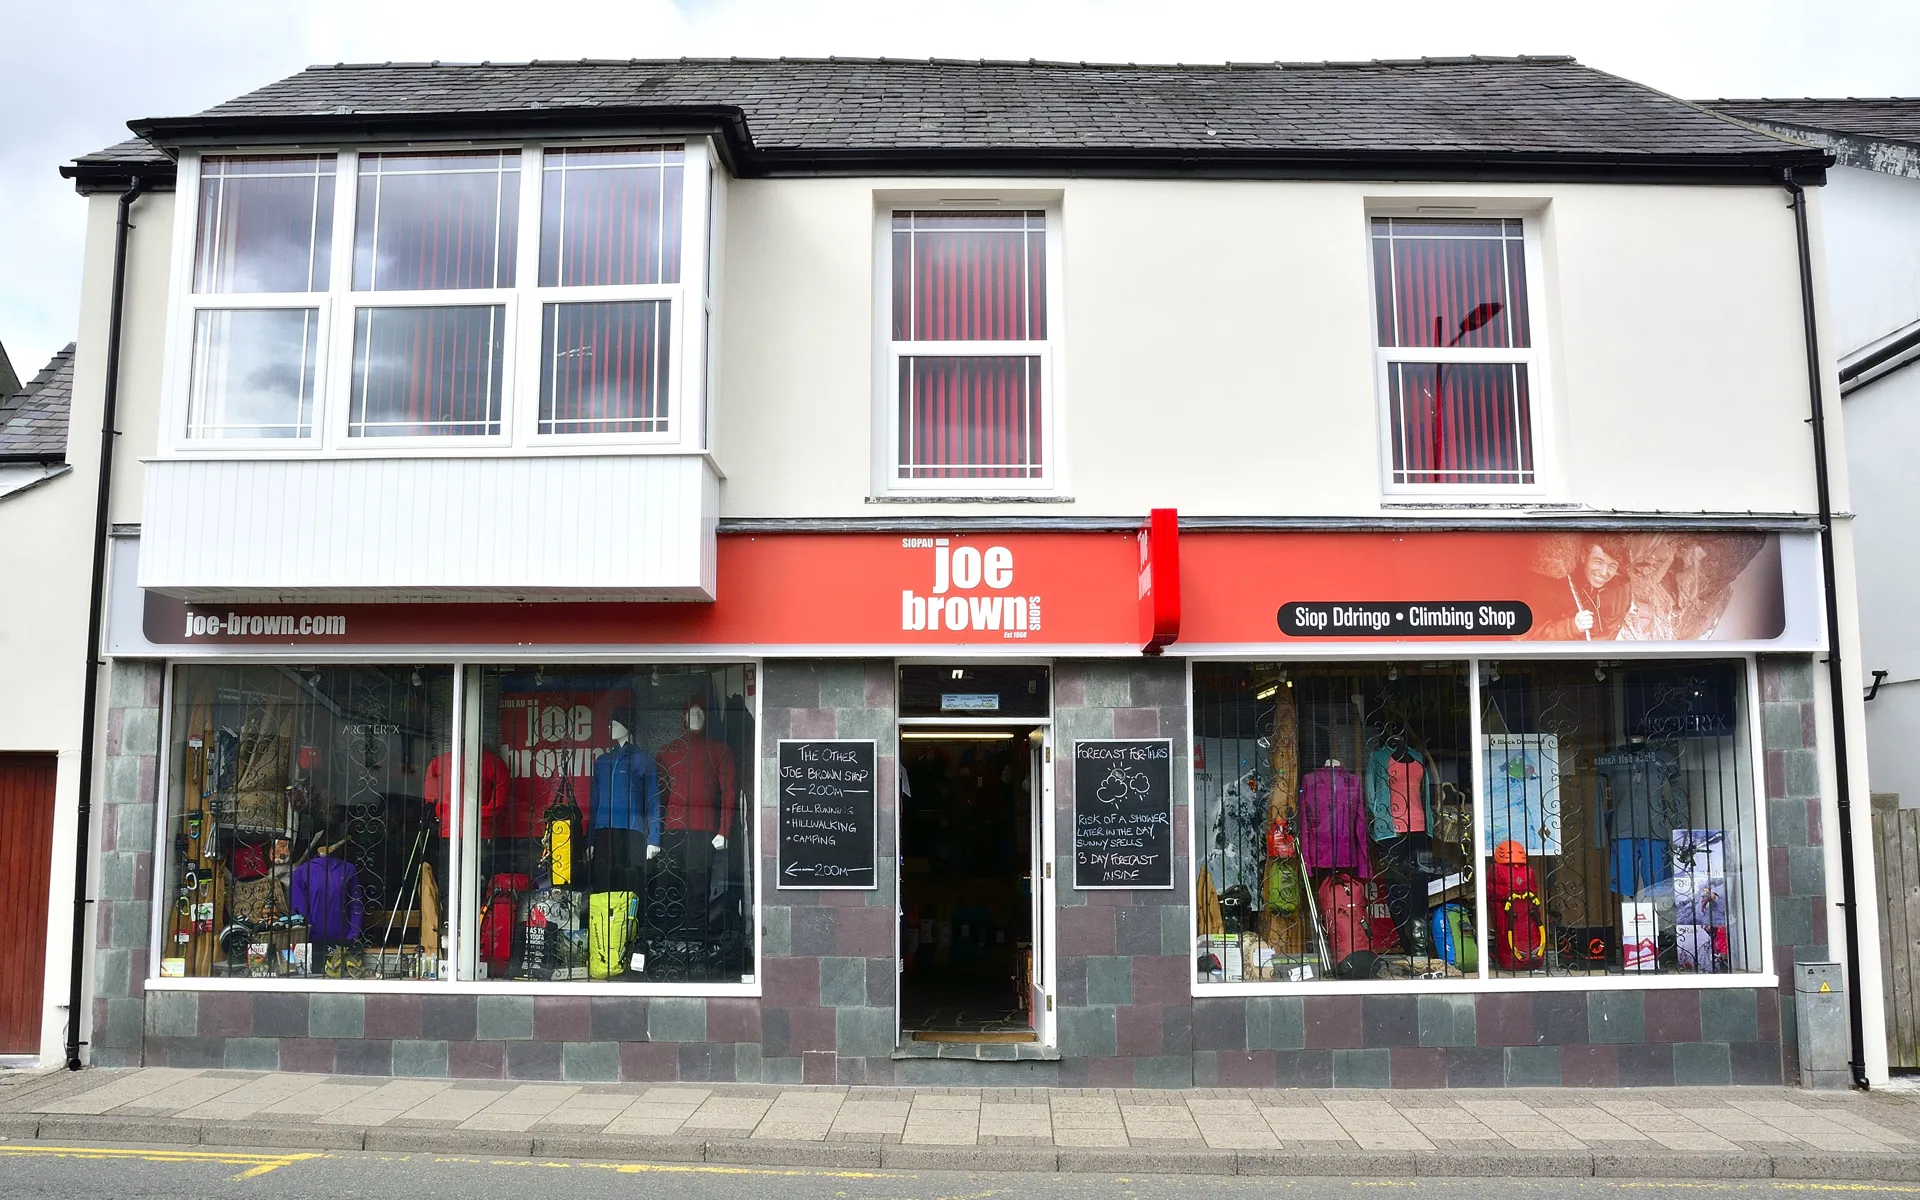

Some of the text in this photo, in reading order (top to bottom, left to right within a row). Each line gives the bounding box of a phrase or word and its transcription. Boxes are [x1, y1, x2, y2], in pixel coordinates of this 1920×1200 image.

[902, 538, 934, 548] SIOPAU
[932, 538, 1014, 594] joe
[902, 590, 1027, 631] brown
[1029, 596, 1041, 631] SHOPS
[1295, 605, 1516, 631] Siop Ddringo Climbing Shop
[184, 611, 346, 638] joe-brown.com
[1003, 631, 1013, 639] Est
[525, 699, 592, 747] joe
[797, 744, 858, 764] THE OTHER
[1077, 742, 1128, 760] FORECAST
[780, 765, 869, 783] JOE BROWN SHOP
[791, 803, 813, 814] FELL
[792, 818, 857, 833] HILLWALKING
[1078, 812, 1169, 826] RISK OF A SHOWER
[792, 834, 836, 846] CAMPING
[1077, 827, 1105, 838] LATER
[1105, 828, 1116, 836] IN
[1117, 827, 1134, 836] THE
[1076, 838, 1144, 850] SUNNY SPELLS
[1077, 851, 1159, 869] 3 DAY FORECAST
[1102, 869, 1140, 881] INSIDE
